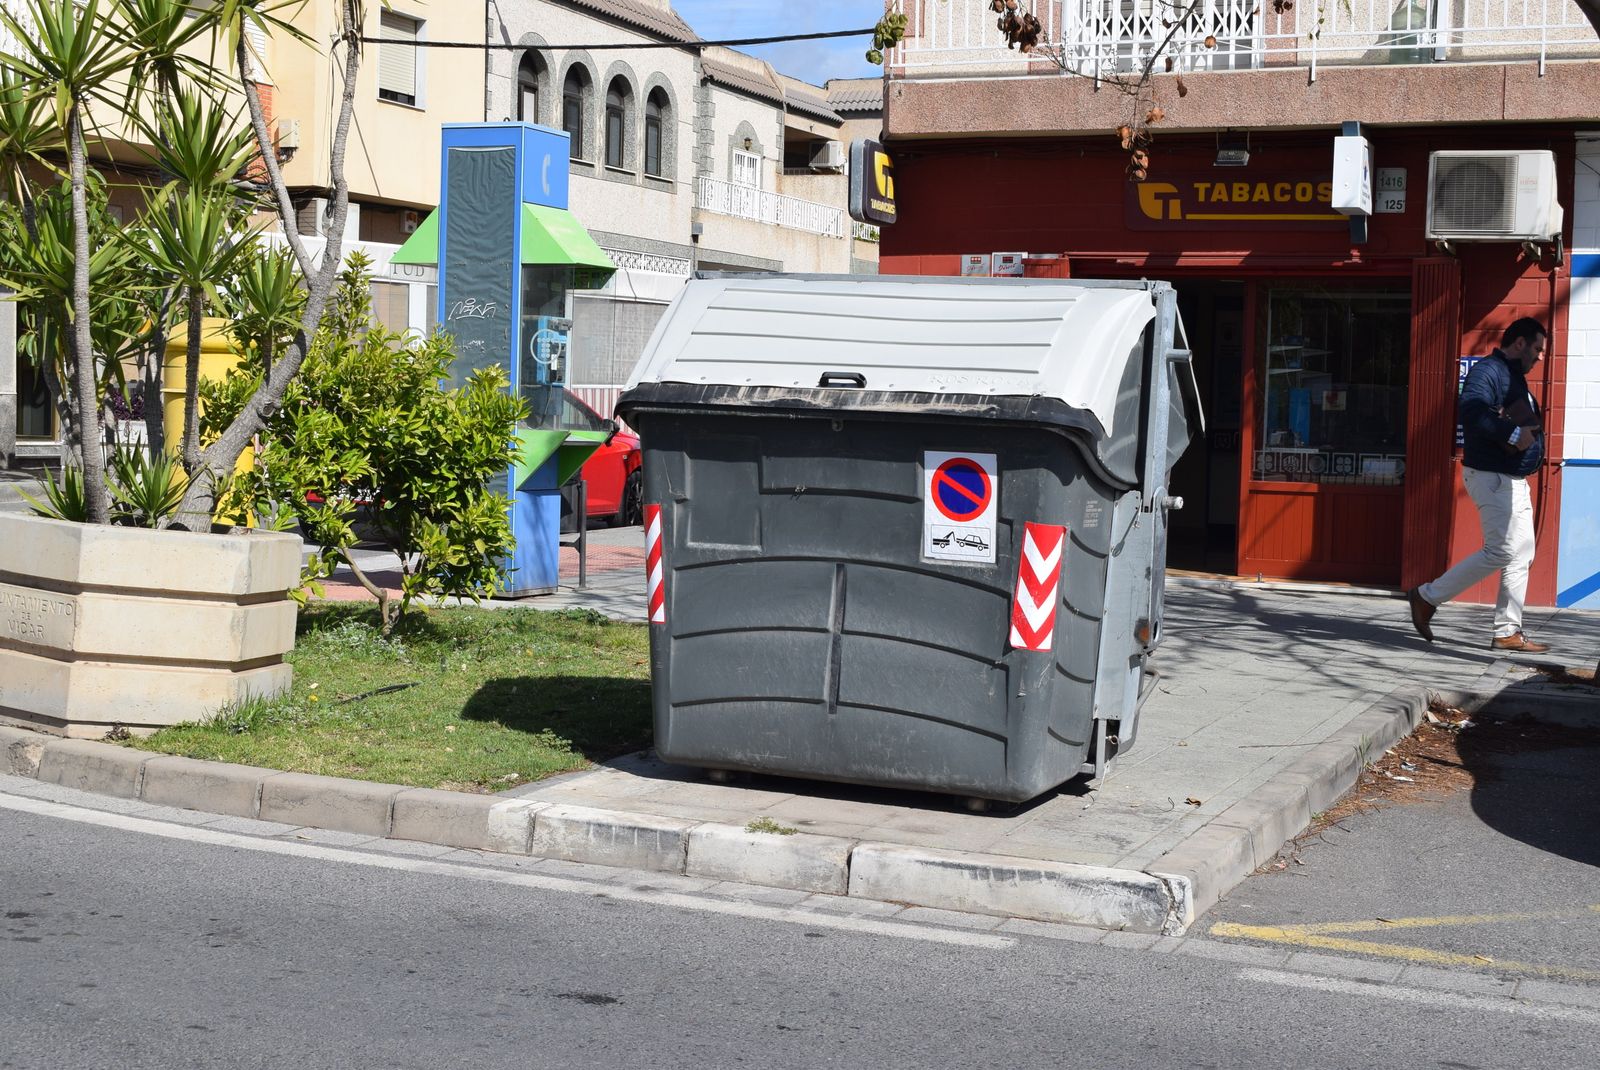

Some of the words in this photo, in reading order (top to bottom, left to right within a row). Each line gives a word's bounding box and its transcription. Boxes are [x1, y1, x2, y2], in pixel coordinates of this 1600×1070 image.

[1193, 182, 1332, 202] TABACOS
[1385, 199, 1403, 210] 125
[7, 619, 45, 639] VICAR
